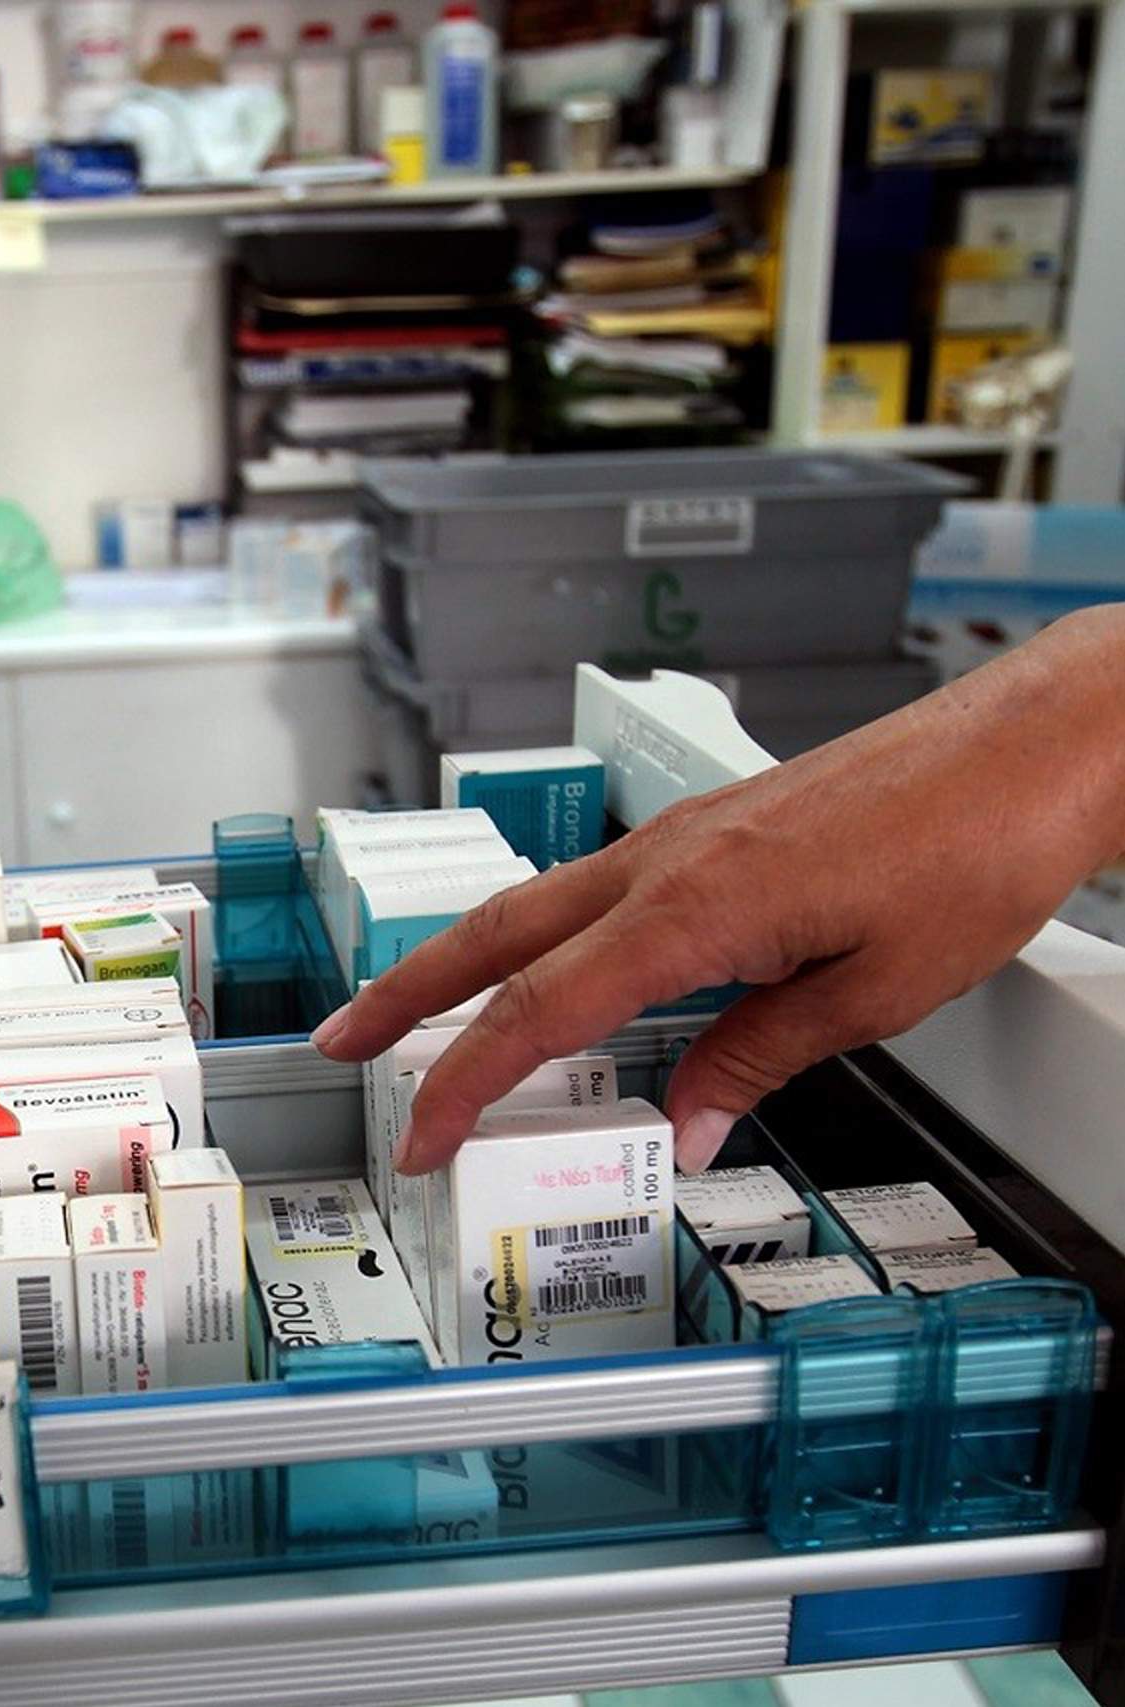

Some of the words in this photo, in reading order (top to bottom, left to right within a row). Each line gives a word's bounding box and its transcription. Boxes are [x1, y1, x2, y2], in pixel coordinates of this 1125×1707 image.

[644, 569, 701, 641] G
[99, 962, 168, 980] Brimogan
[591, 1071, 605, 1098] mg
[645, 1141, 661, 1168] mg
[623, 1143, 635, 1198] coated
[645, 1172, 660, 1203] 100
